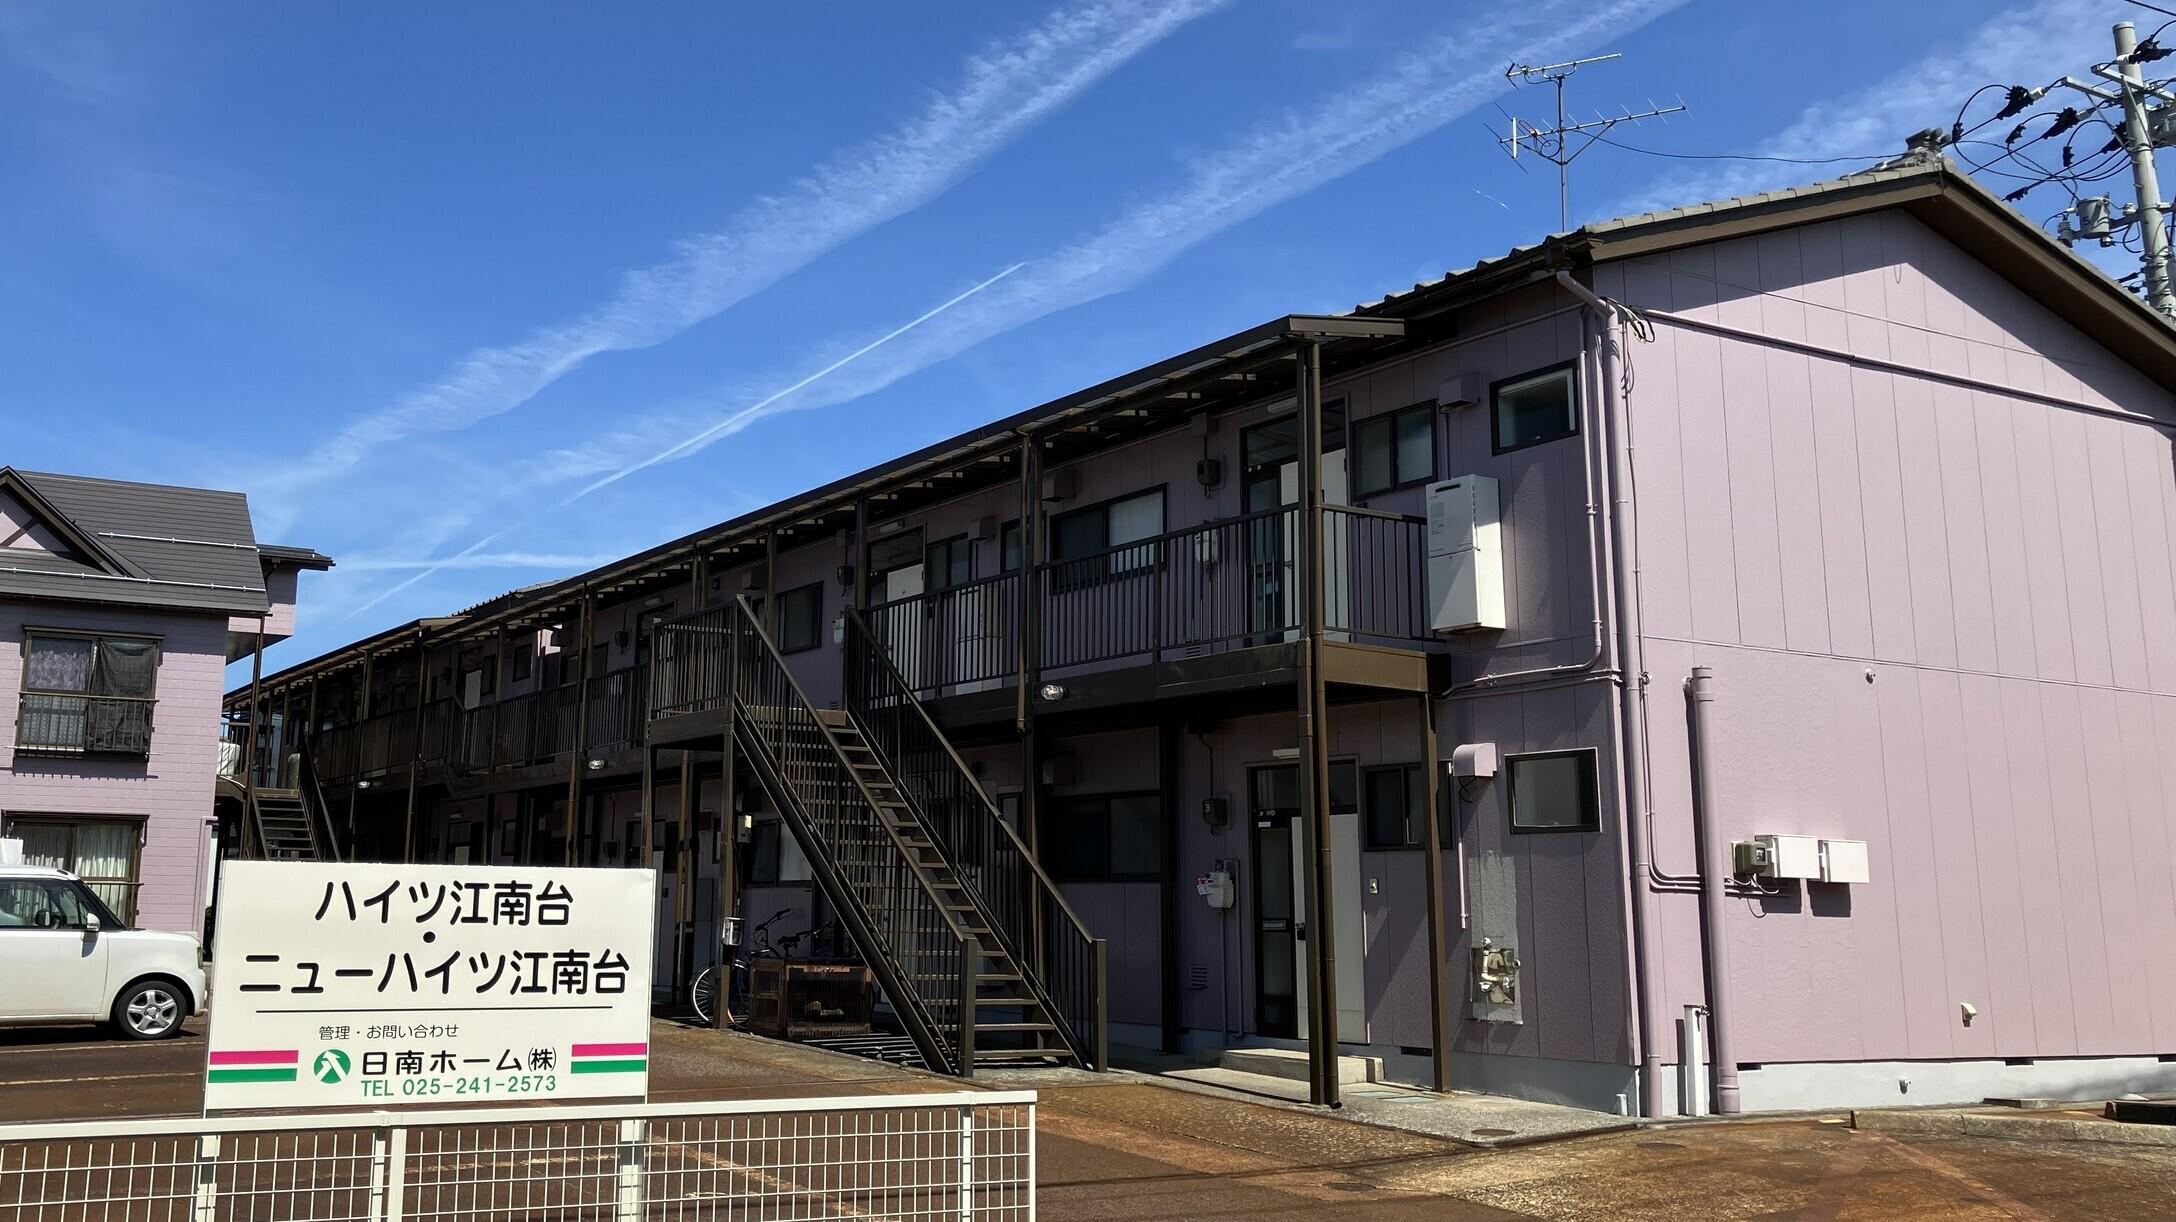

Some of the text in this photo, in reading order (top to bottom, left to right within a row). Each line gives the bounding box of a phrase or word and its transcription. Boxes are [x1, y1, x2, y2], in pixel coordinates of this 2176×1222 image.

[314, 879, 574, 926] ハイツ江南台
[239, 948, 630, 995] ニューハイツ江南台
[318, 1023, 459, 1041] 管理・お問い合わせ
[360, 1075, 557, 1096] TEL 025-241-2573
